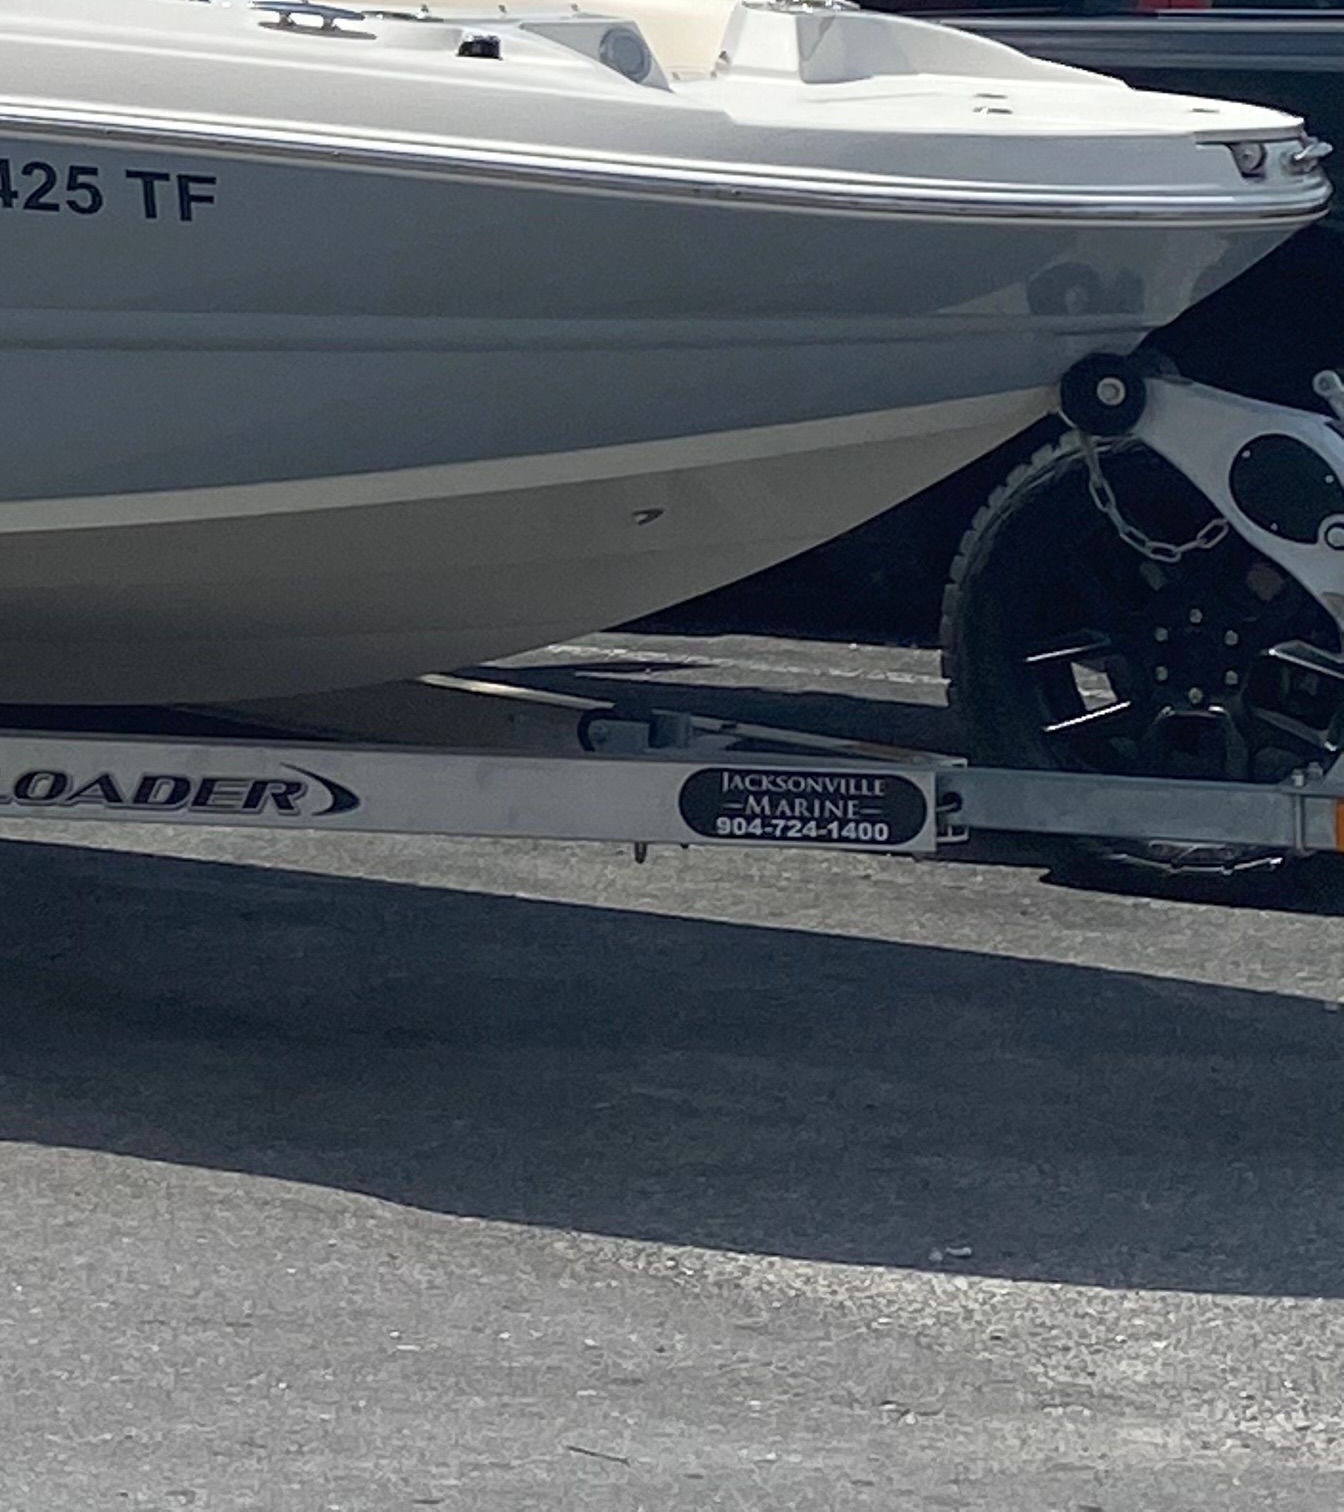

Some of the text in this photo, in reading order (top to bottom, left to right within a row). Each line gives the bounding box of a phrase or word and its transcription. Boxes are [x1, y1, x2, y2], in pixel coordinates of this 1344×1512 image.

[125, 169, 217, 222] TF
[722, 771, 886, 796] JACKSONVILLE
[744, 795, 861, 819] MARINE
[715, 816, 889, 841] 904-724-1400
